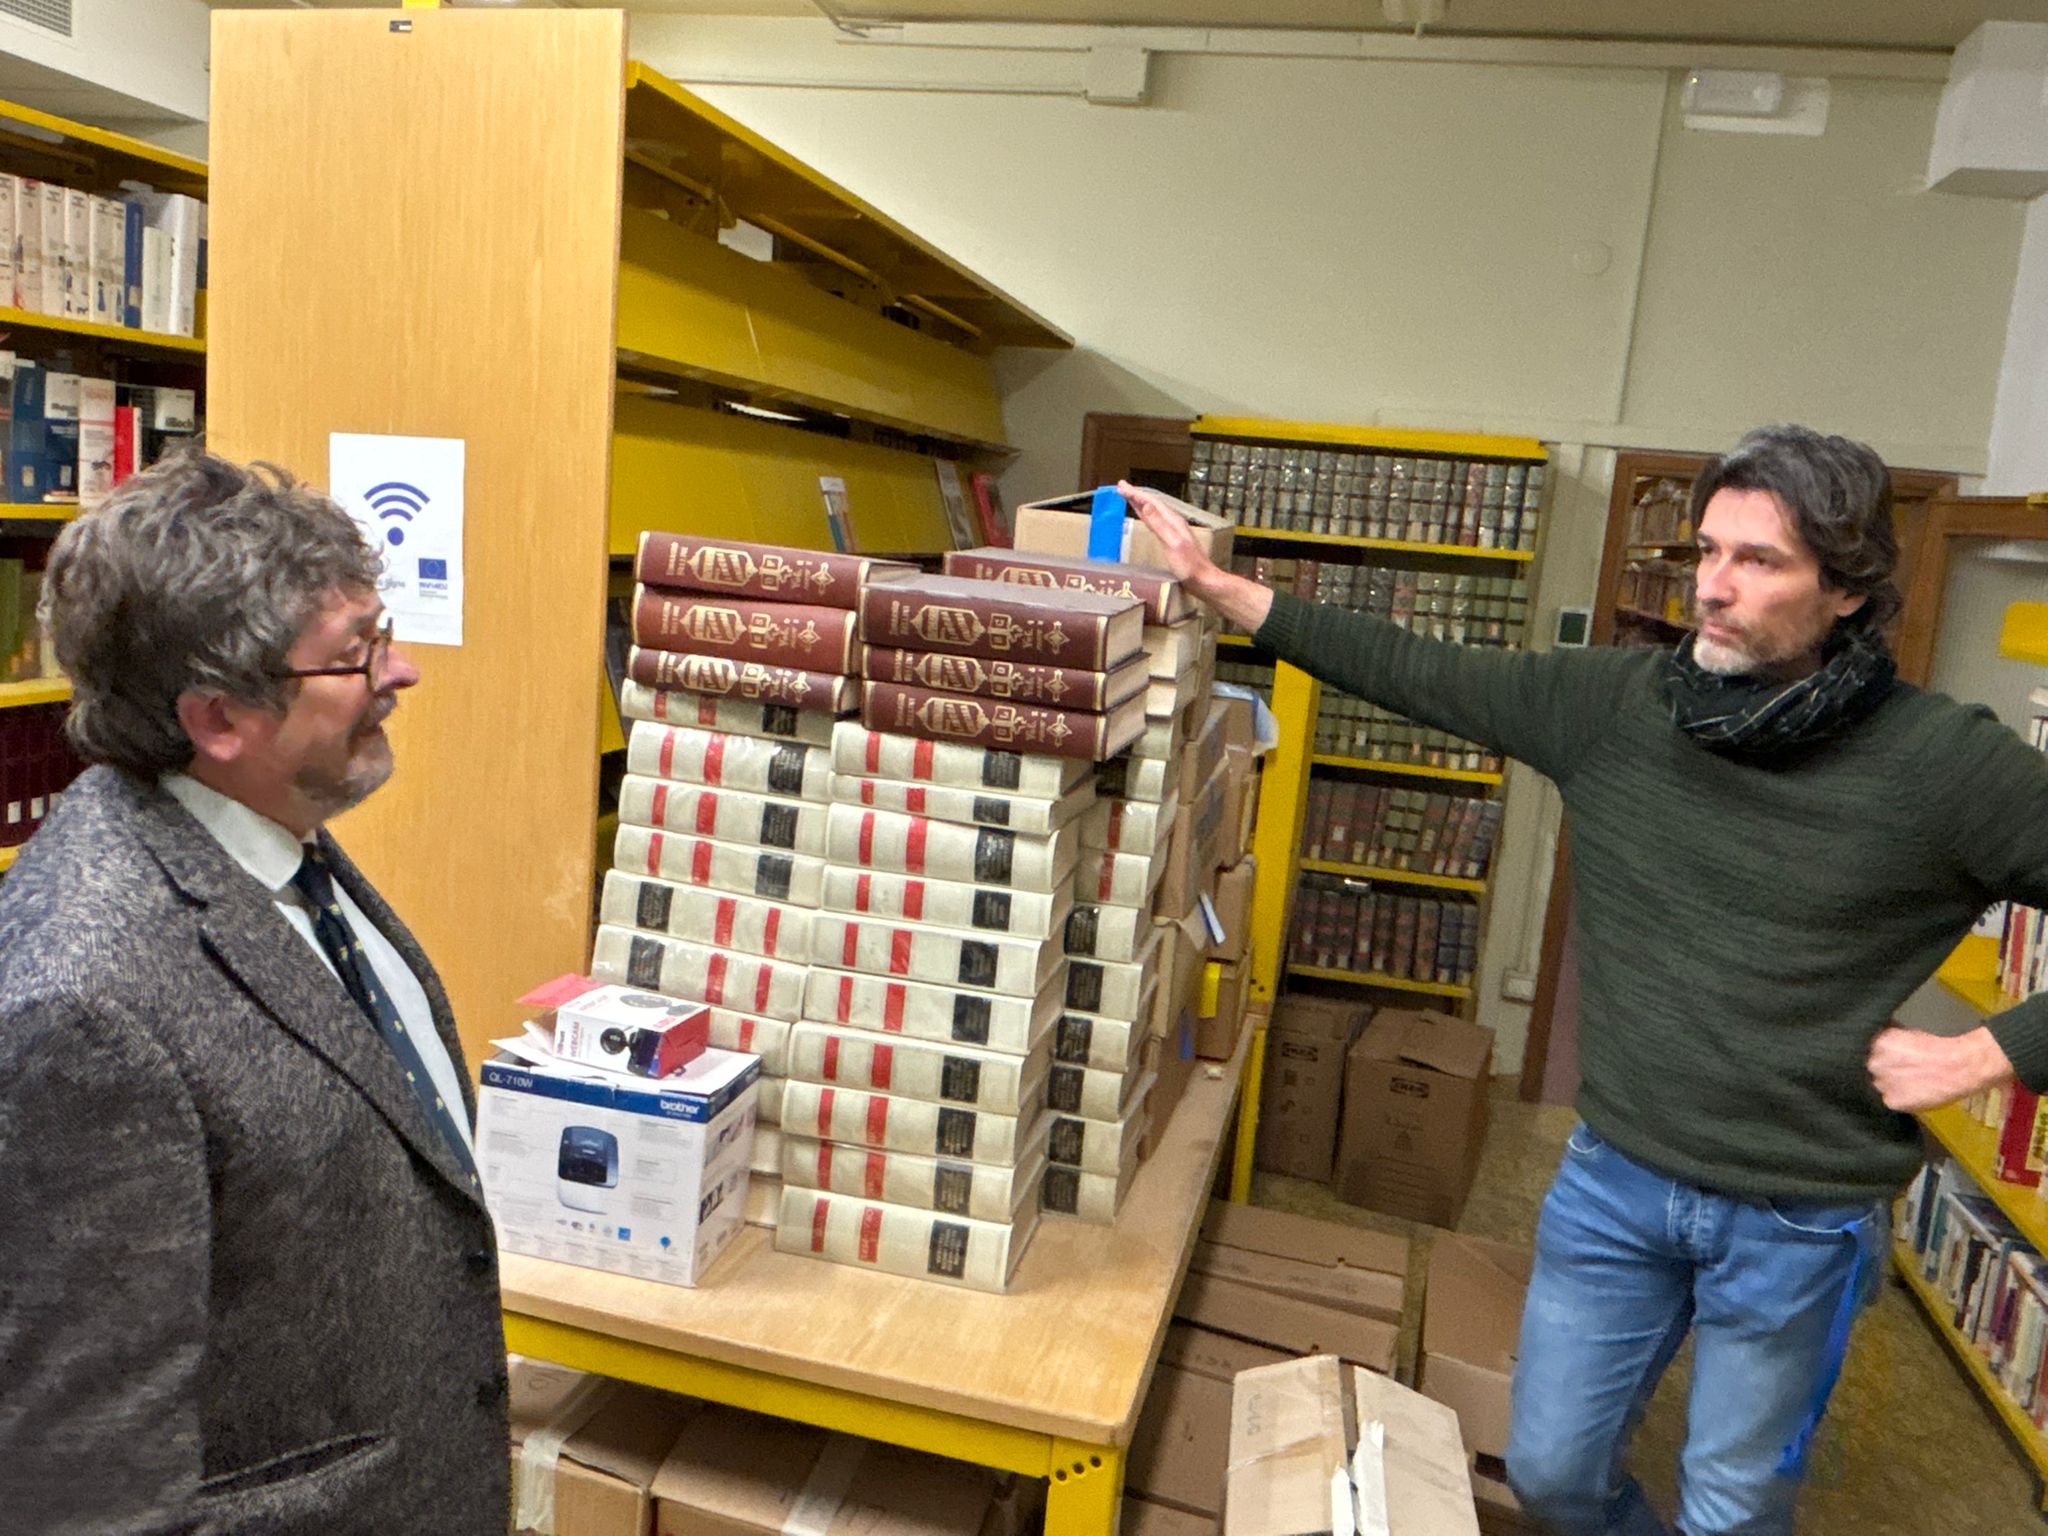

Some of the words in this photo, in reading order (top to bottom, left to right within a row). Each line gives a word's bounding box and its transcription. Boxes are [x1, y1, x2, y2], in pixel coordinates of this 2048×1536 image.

[570, 1021, 580, 1057] WEBCAM
[488, 1071, 534, 1089] QL-710W
[659, 1099, 700, 1115] brother
